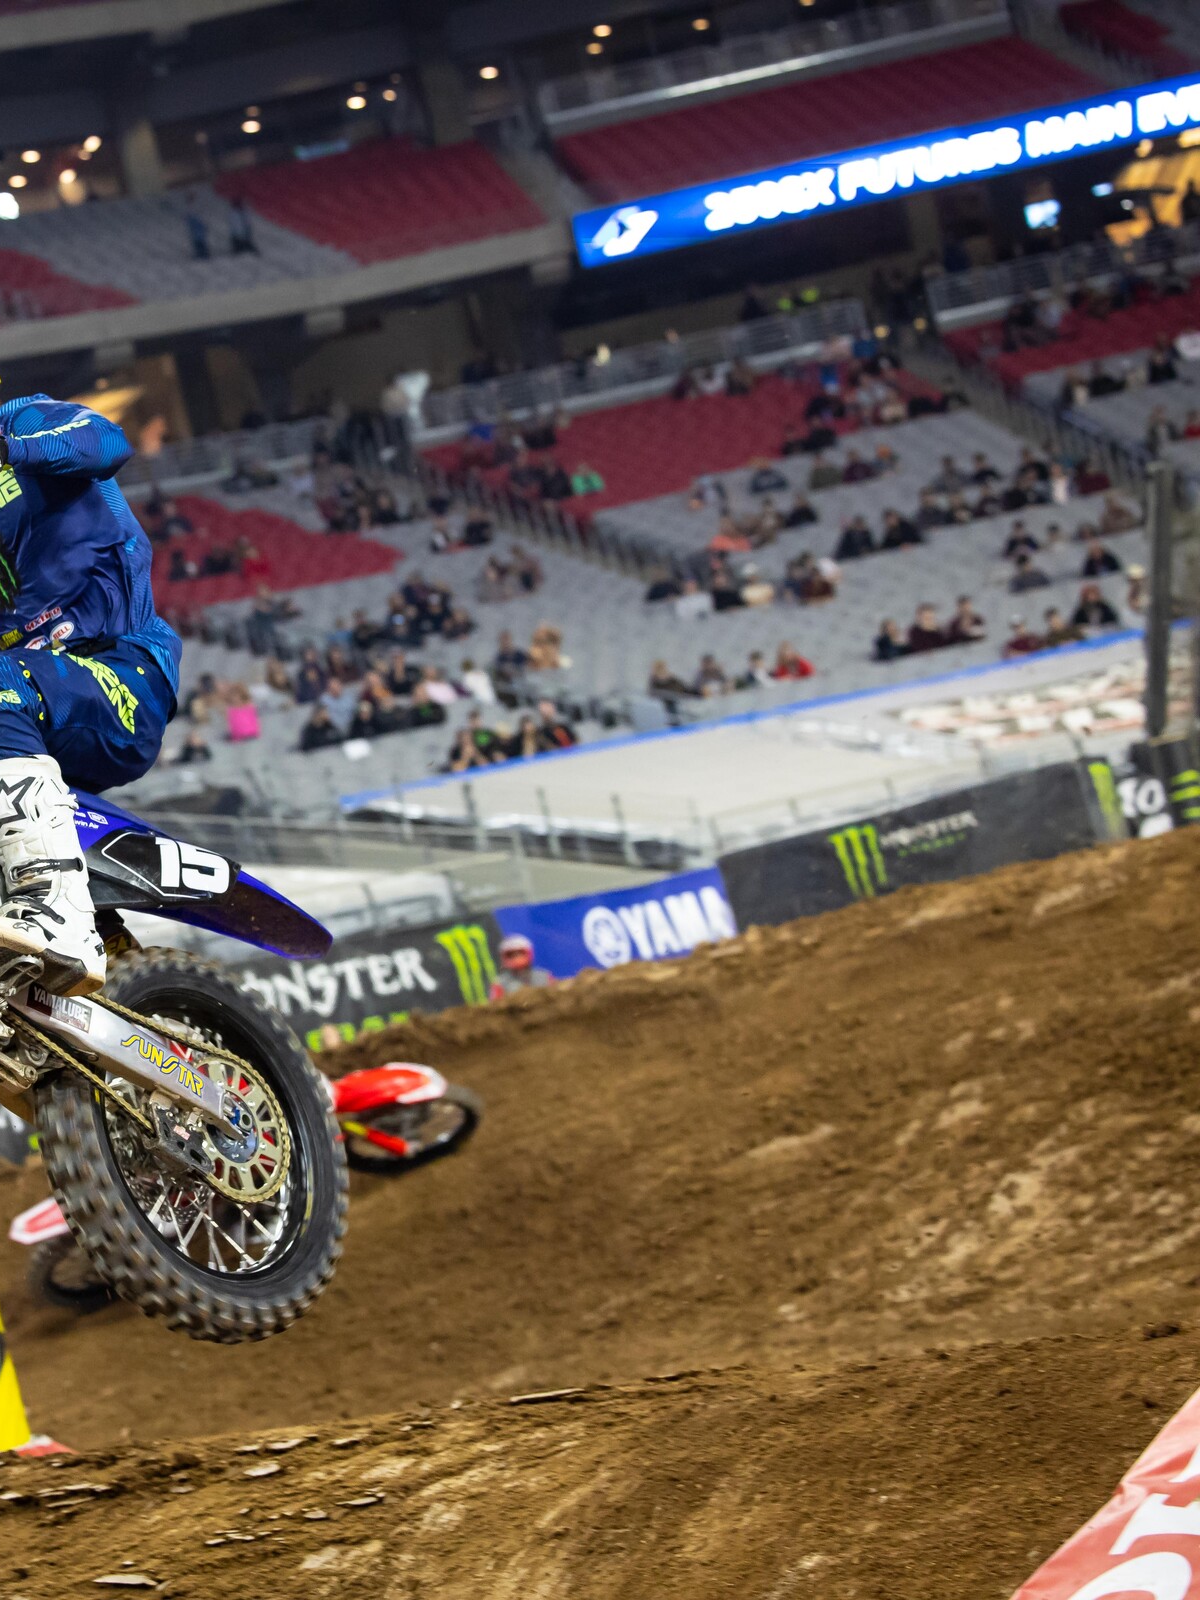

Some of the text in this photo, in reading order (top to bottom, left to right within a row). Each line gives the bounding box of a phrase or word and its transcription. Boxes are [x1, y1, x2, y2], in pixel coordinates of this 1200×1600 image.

[837, 127, 1022, 201] FUTURES
[1024, 101, 1133, 158] MAIN
[52, 626, 70, 640] BELL
[155, 837, 230, 894] 15
[33, 985, 91, 1025] YAMALUBE
[239, 947, 438, 1018] ONSTER
[120, 1034, 205, 1099] SUNSTAR
